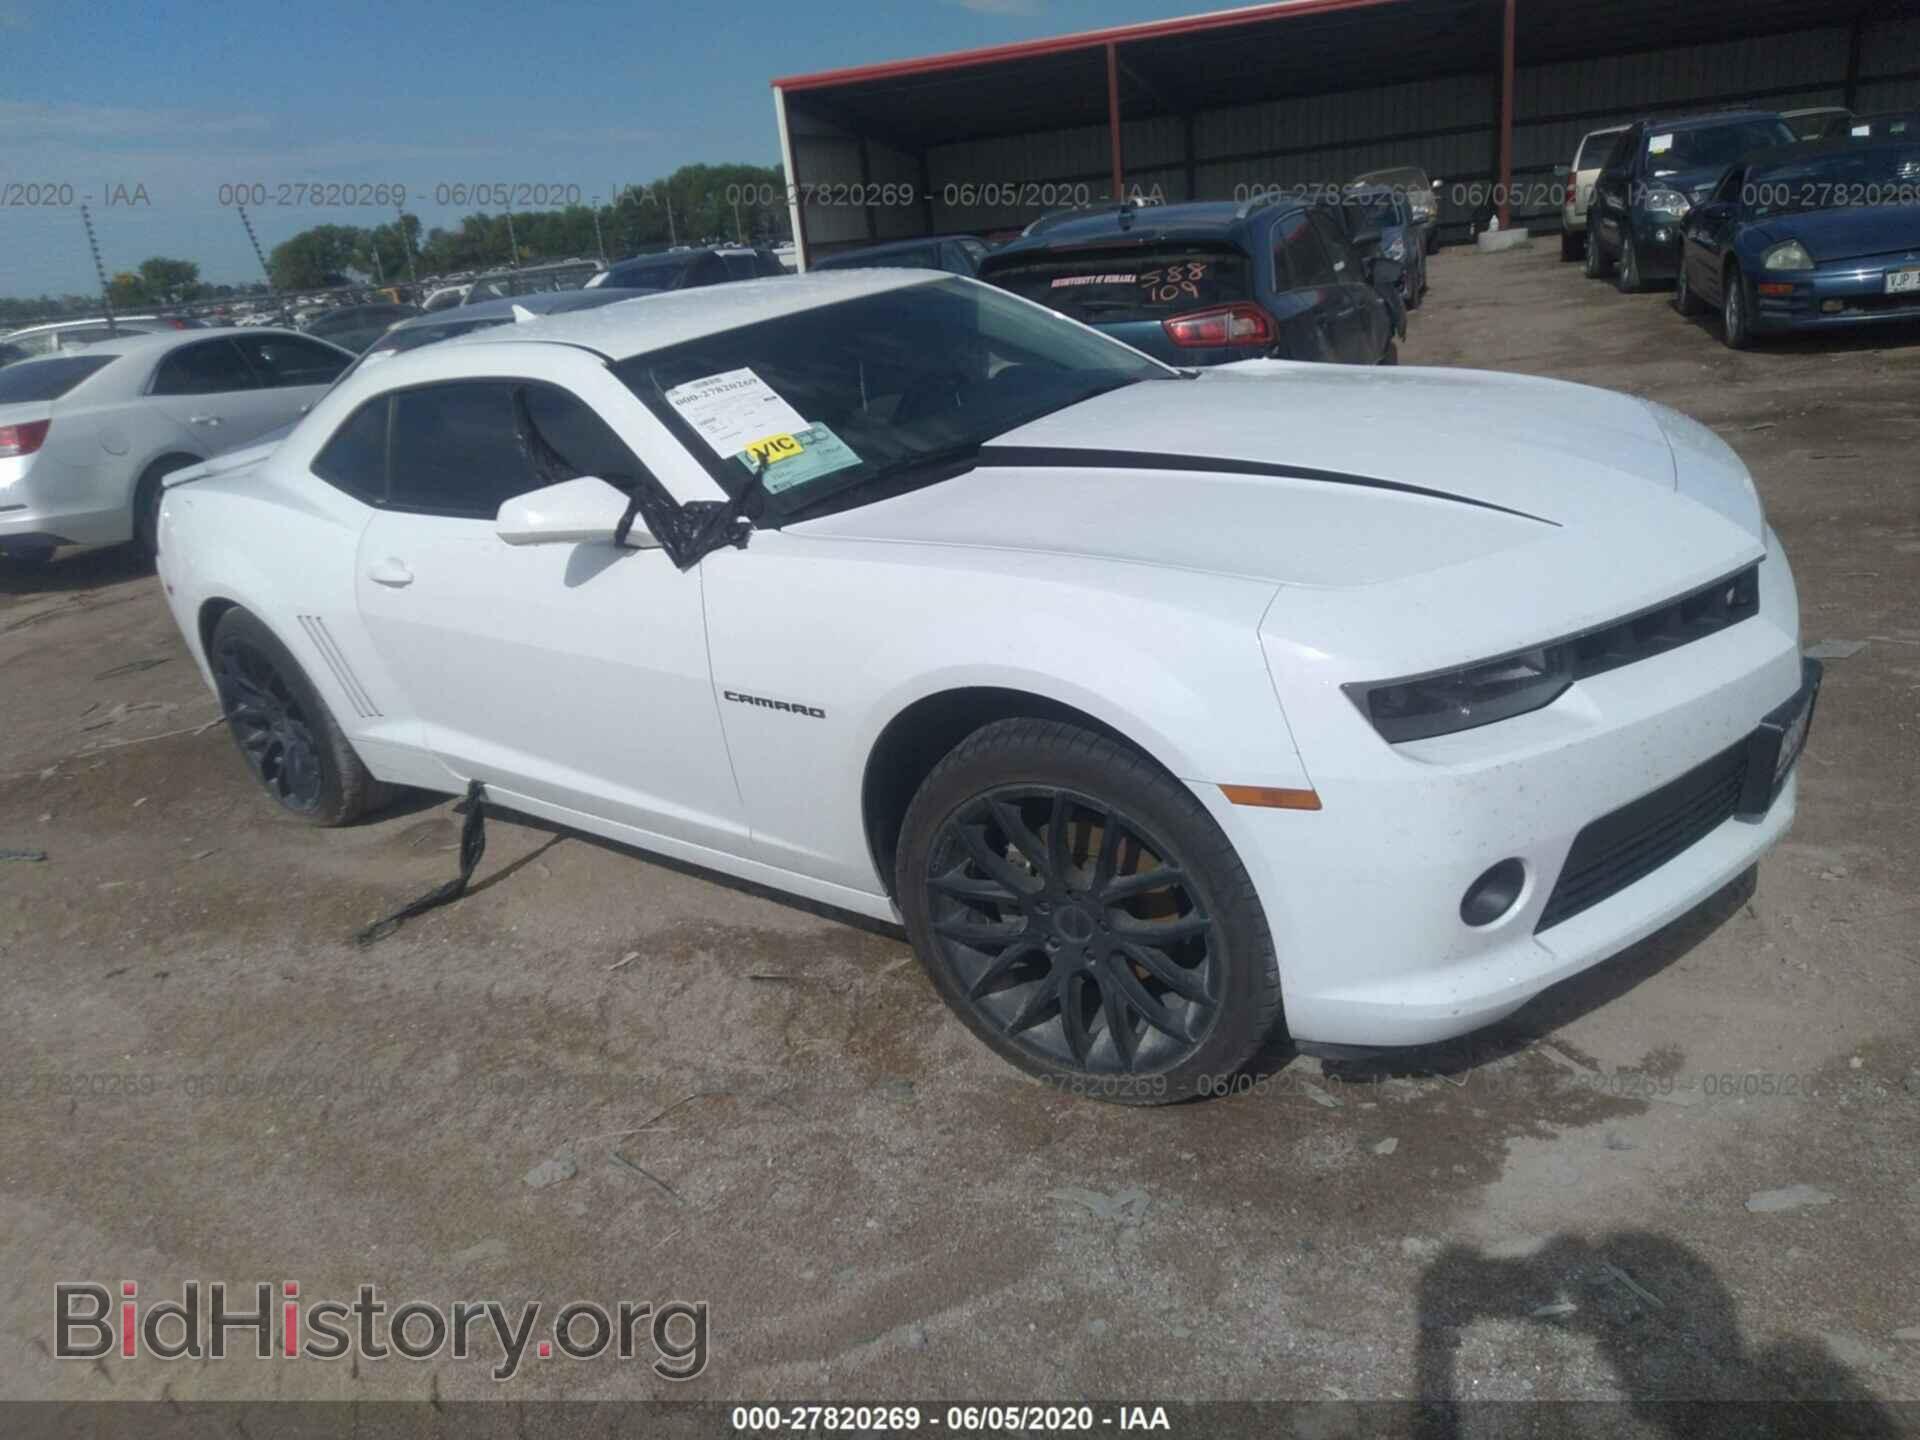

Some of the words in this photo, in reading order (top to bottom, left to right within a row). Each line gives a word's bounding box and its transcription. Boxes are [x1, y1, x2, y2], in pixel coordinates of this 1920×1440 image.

[1152, 281, 1199, 301] 109
[752, 437, 796, 459] VIC
[723, 690, 826, 719] CAMARO
